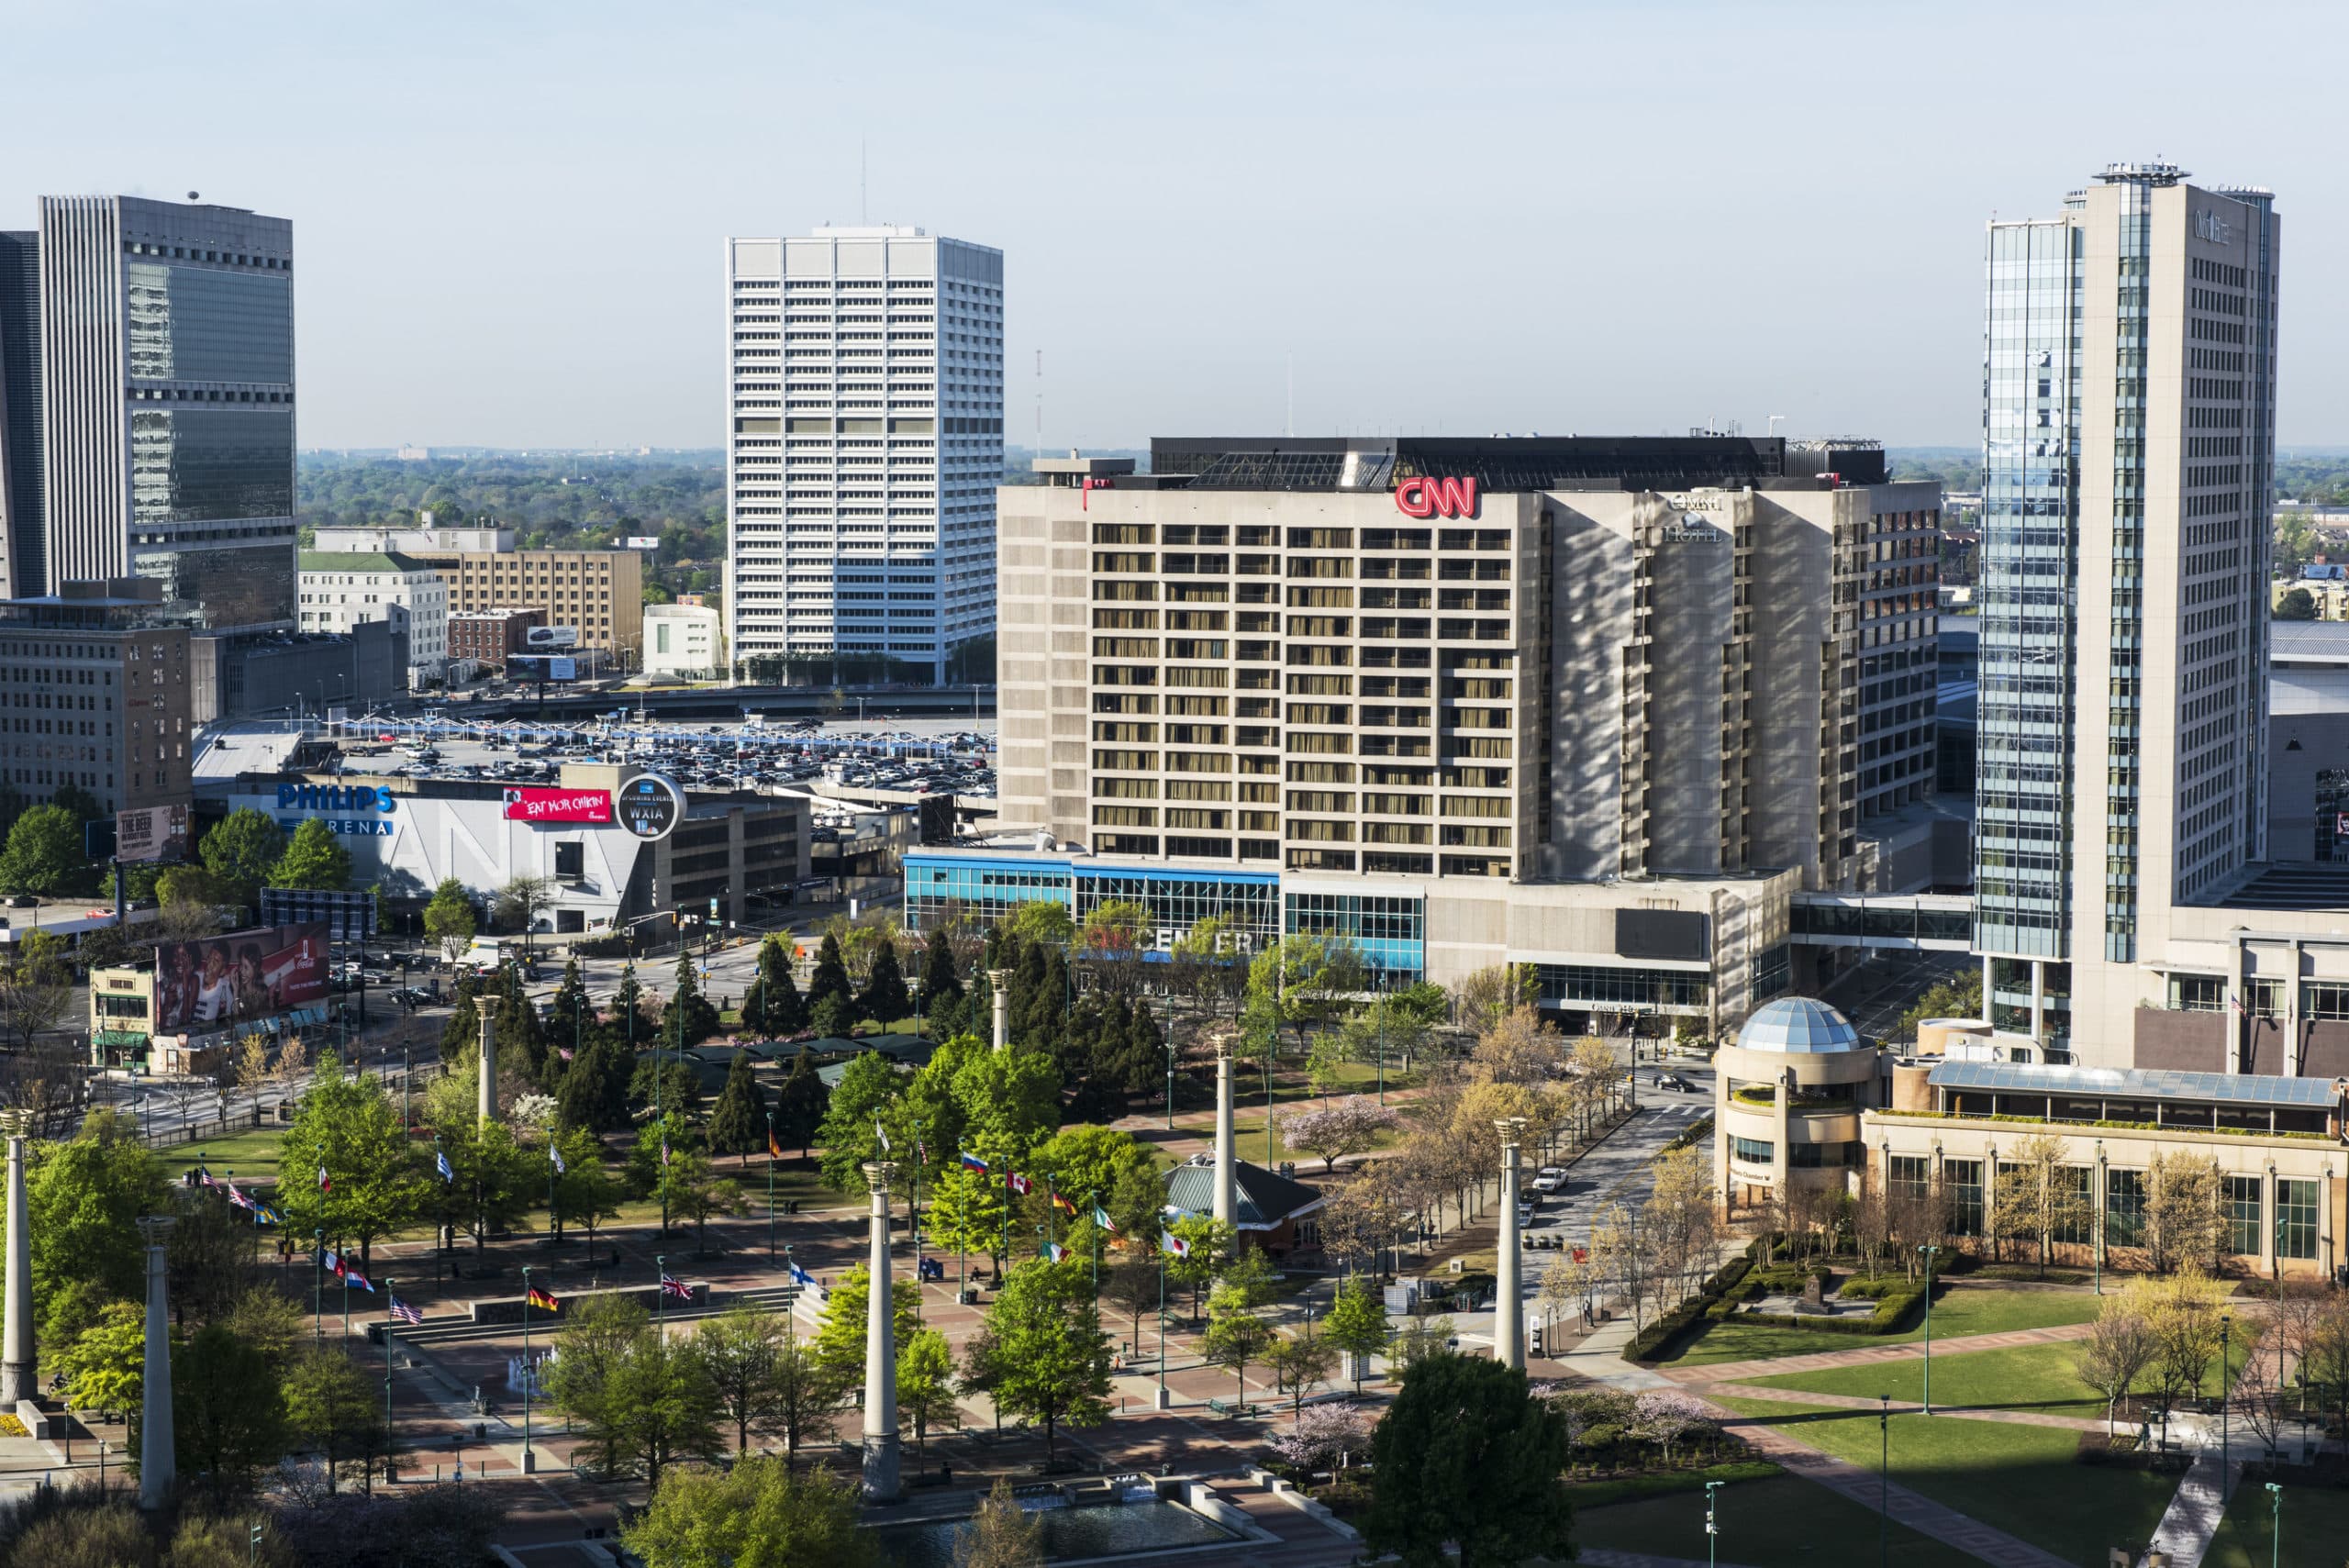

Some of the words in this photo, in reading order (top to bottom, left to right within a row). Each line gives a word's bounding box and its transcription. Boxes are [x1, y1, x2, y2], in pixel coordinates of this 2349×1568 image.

[1395, 476, 1475, 517] CNN
[1667, 495, 1724, 511] OMNI
[1664, 526, 1724, 543] HOTEL
[278, 783, 392, 812] PHILIPS
[548, 796, 571, 813] MOR
[573, 795, 603, 809] CHIKIN
[630, 807, 663, 819] WXIA
[121, 818, 135, 833] THE
[135, 817, 152, 831] BEER
[323, 820, 387, 835] RENA
[1135, 928, 1252, 955] CENER
